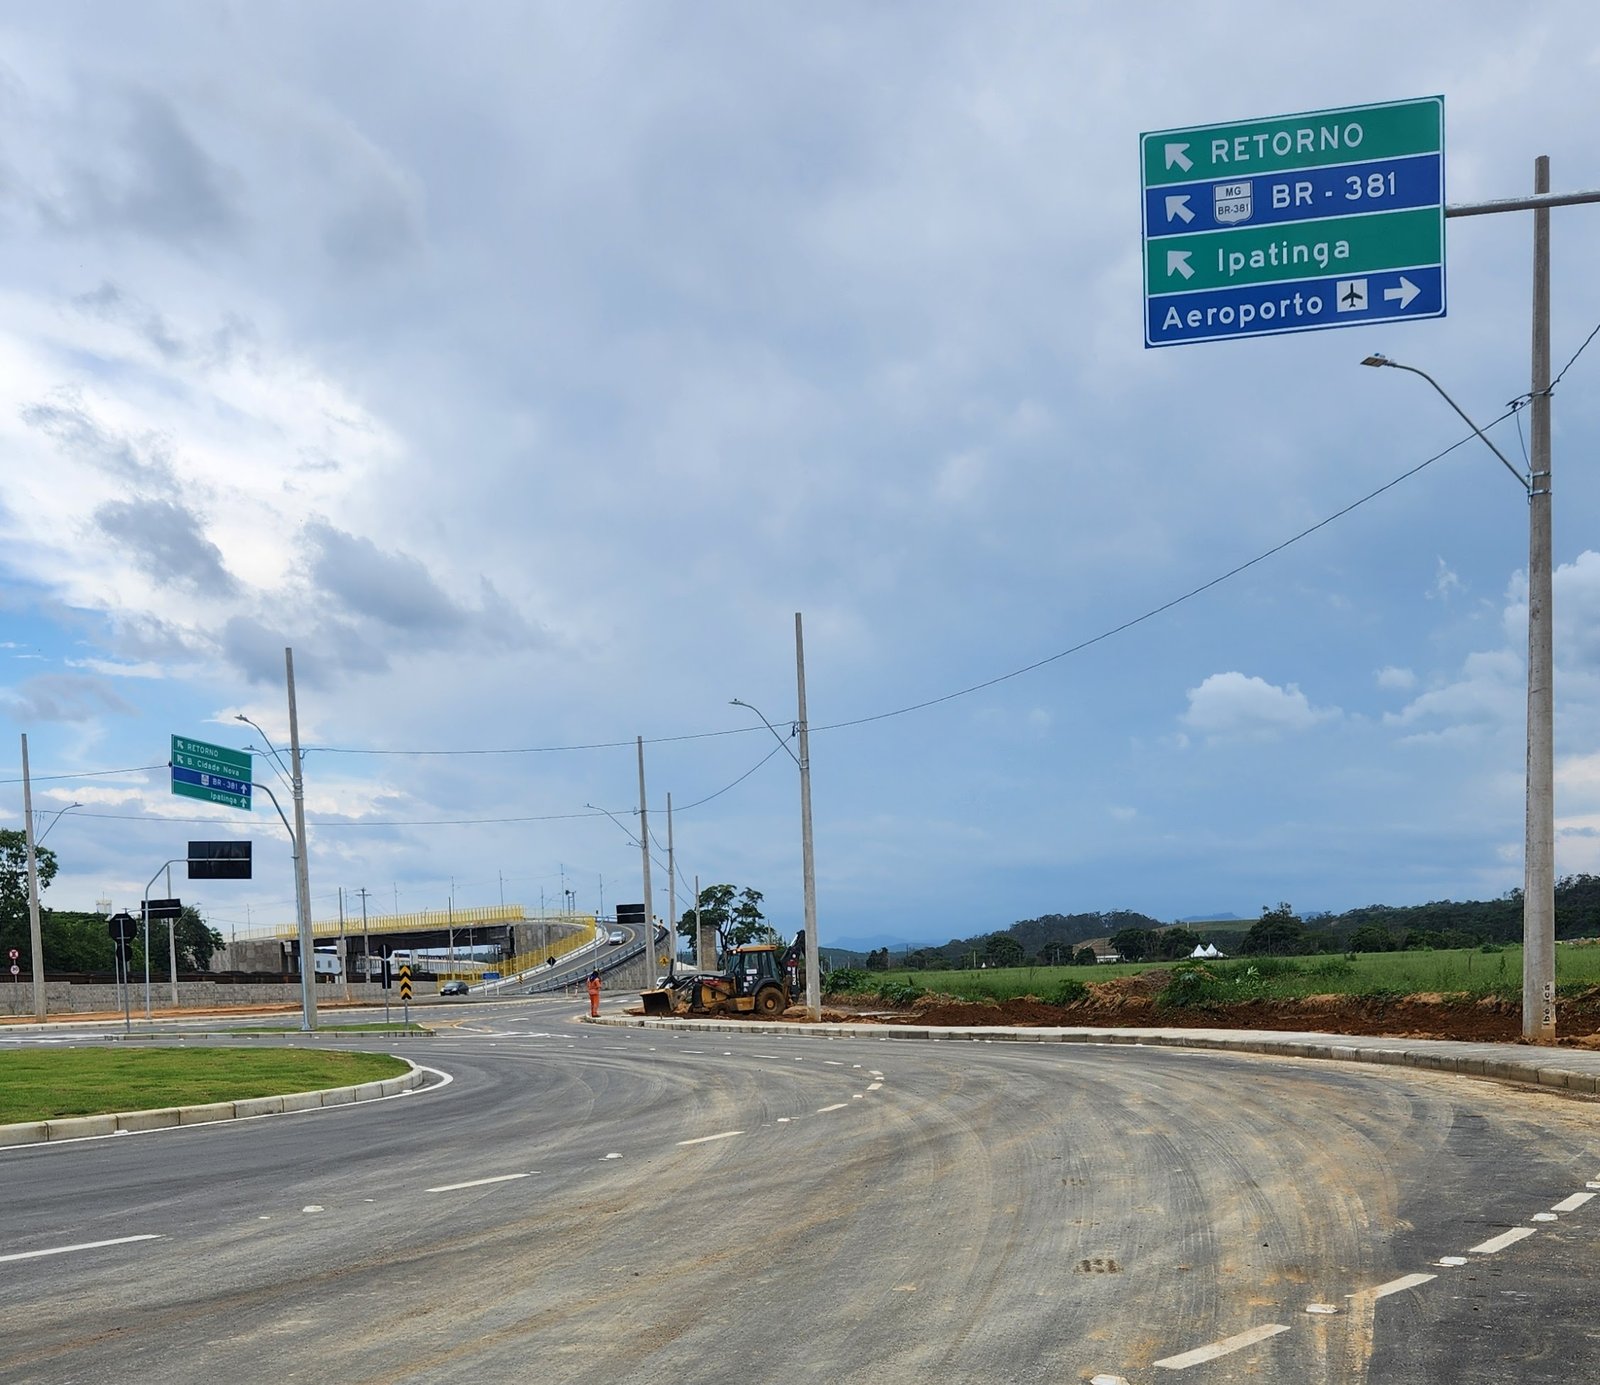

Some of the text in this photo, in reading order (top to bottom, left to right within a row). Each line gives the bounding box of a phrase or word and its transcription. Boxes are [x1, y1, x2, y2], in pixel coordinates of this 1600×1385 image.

[1211, 123, 1363, 164] RETORNO
[1225, 186, 1242, 198] MG
[1272, 182, 1314, 210] BR
[1345, 171, 1397, 201] 381
[1217, 203, 1250, 216] BR-381
[1217, 239, 1351, 277] Ipatinga
[1161, 293, 1324, 331] Aeroporto
[187, 743, 219, 757] RETORNO
[197, 760, 221, 772] Cidade
[223, 766, 240, 777] Nova
[210, 792, 237, 805] Ipatinga
